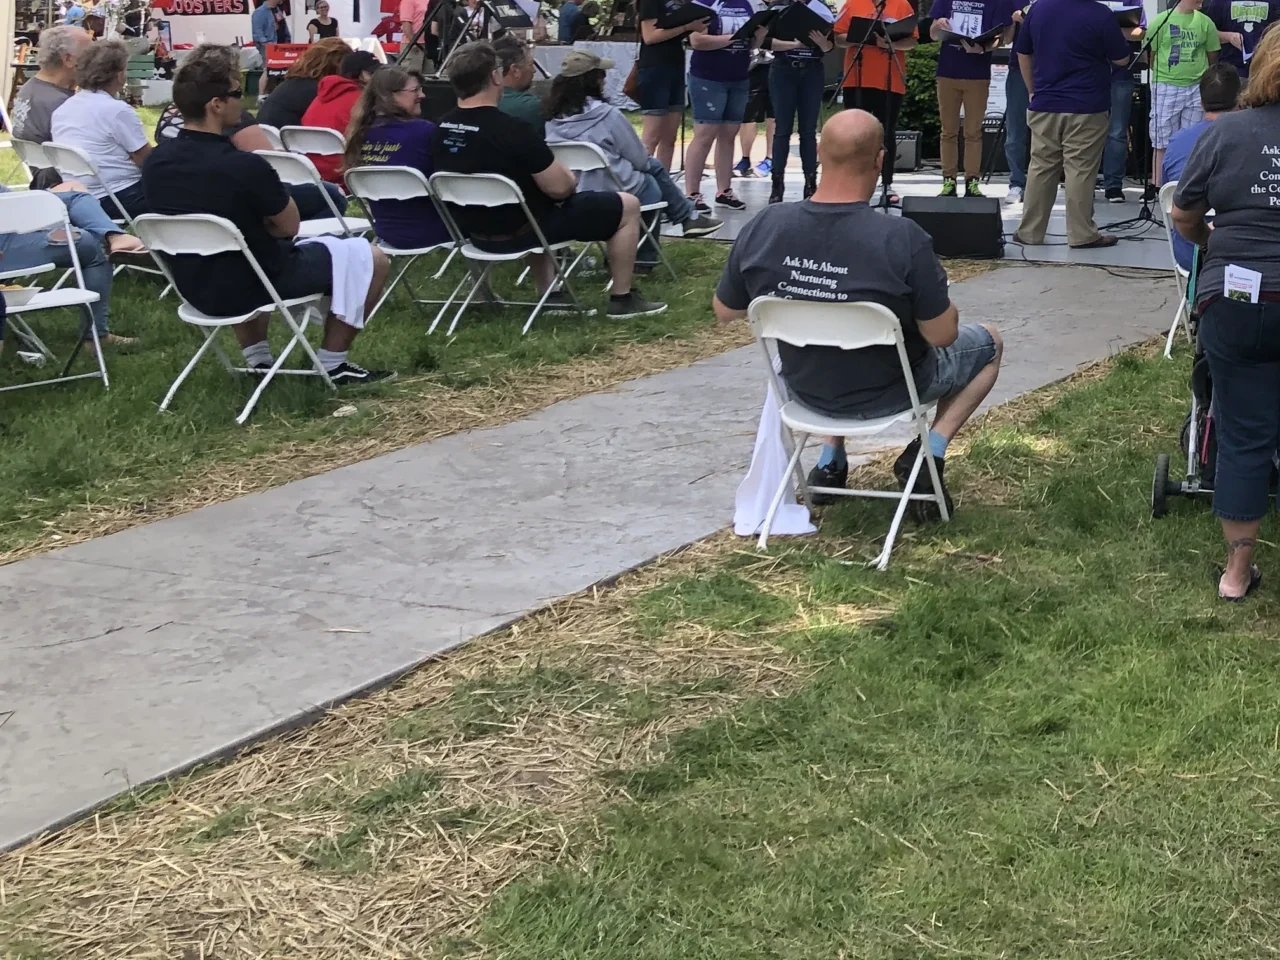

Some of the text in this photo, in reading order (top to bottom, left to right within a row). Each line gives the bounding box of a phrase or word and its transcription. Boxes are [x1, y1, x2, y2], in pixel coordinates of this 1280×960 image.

[1261, 145, 1280, 155] Ask
[1250, 183, 1267, 194] the
[782, 256, 848, 274] Ask Me About
[790, 270, 838, 290] Nurturing
[777, 281, 836, 300] Connections
